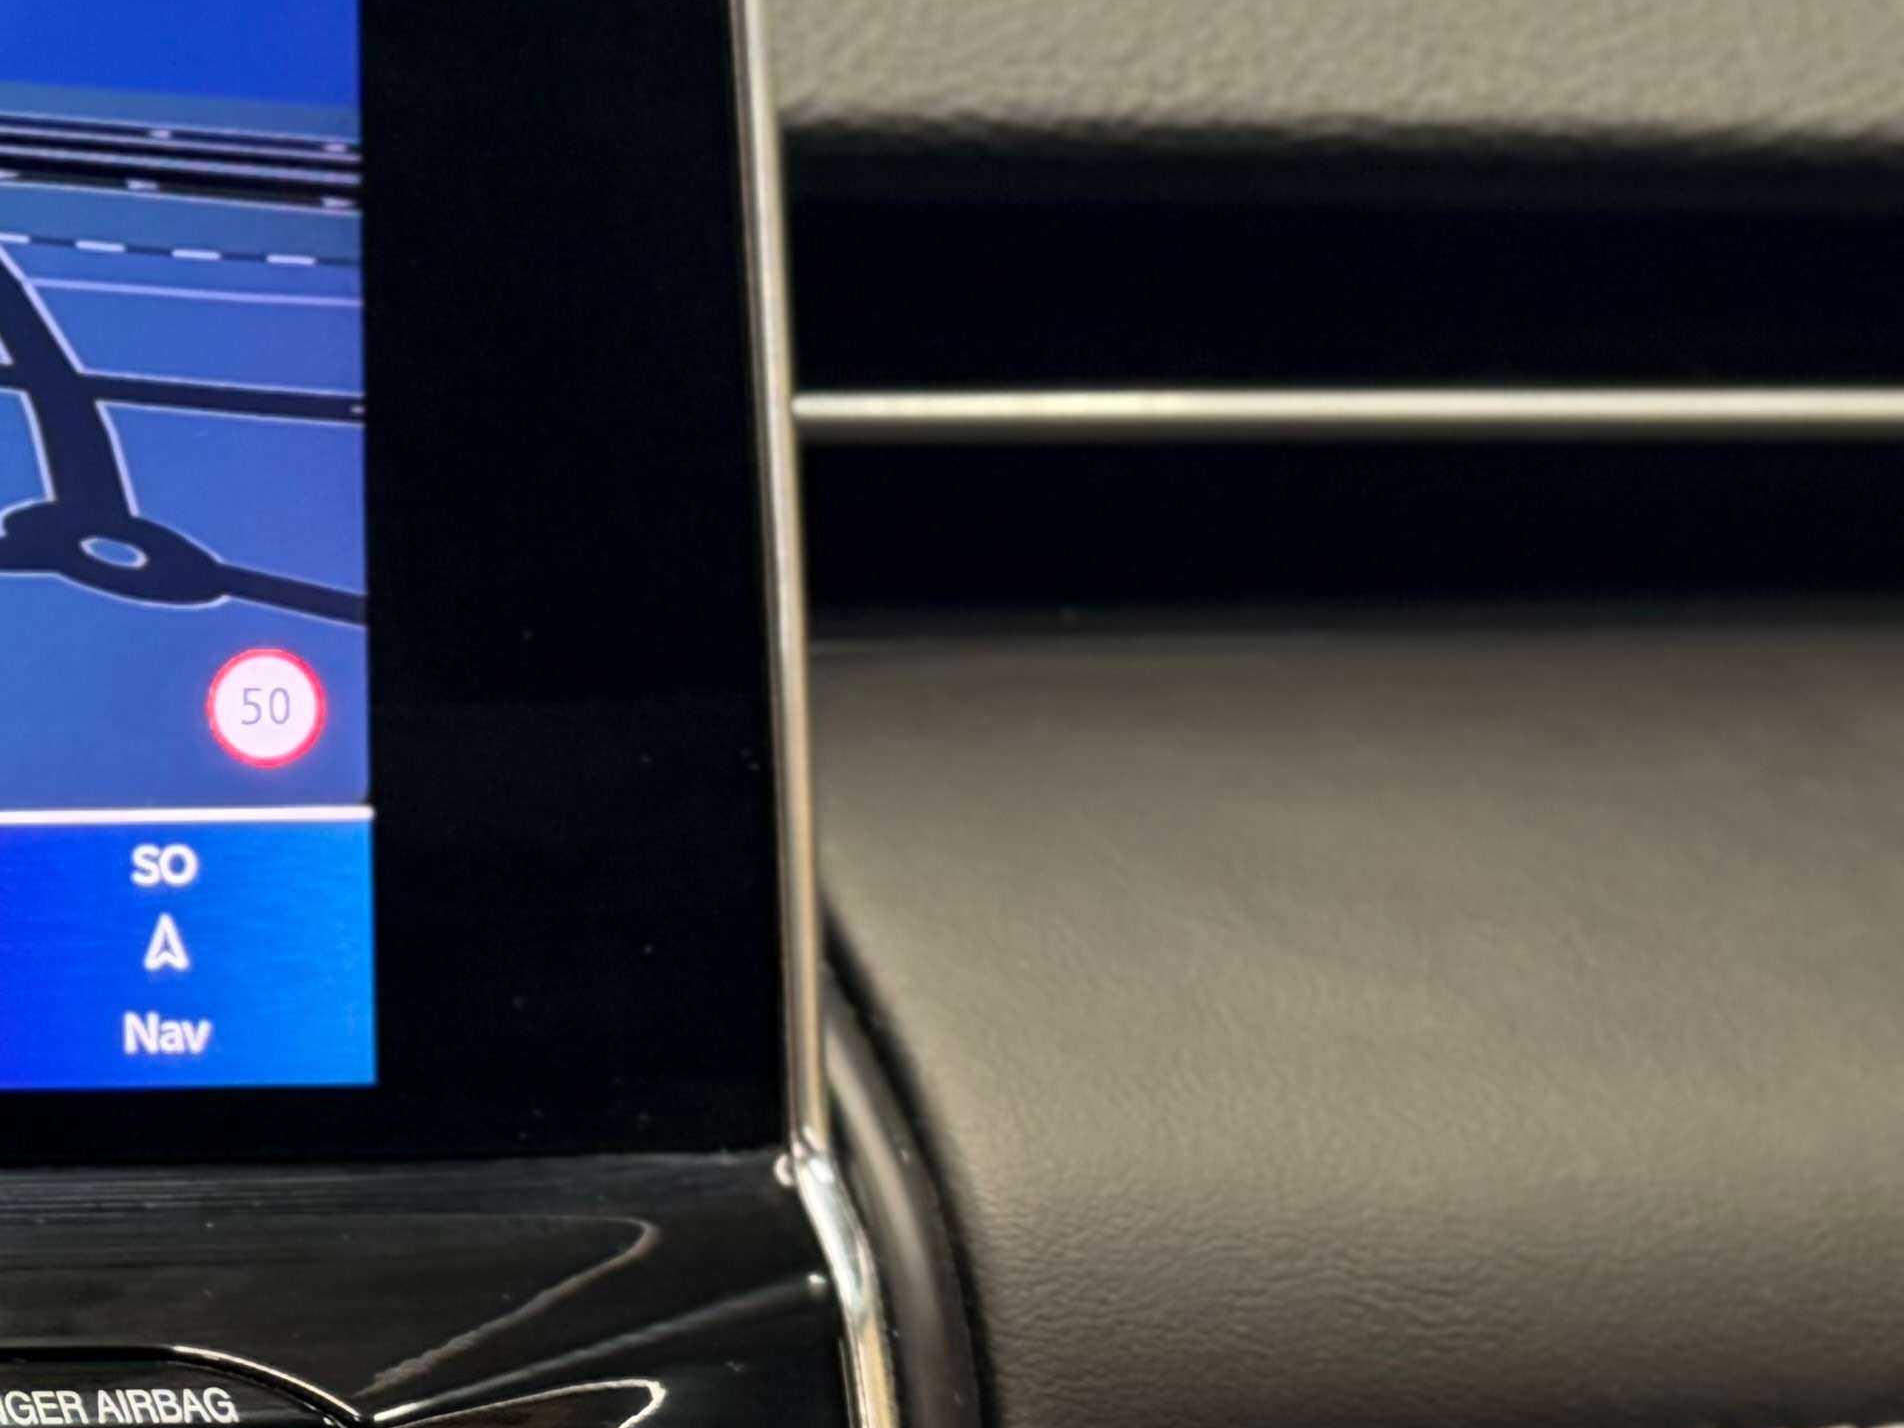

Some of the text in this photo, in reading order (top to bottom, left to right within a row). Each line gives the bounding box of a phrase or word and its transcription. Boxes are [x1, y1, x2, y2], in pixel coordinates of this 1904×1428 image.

[240, 687, 292, 725] 50
[130, 844, 199, 887] SO
[123, 1012, 212, 1054] Nav
[96, 1385, 241, 1425] AIRBAG
